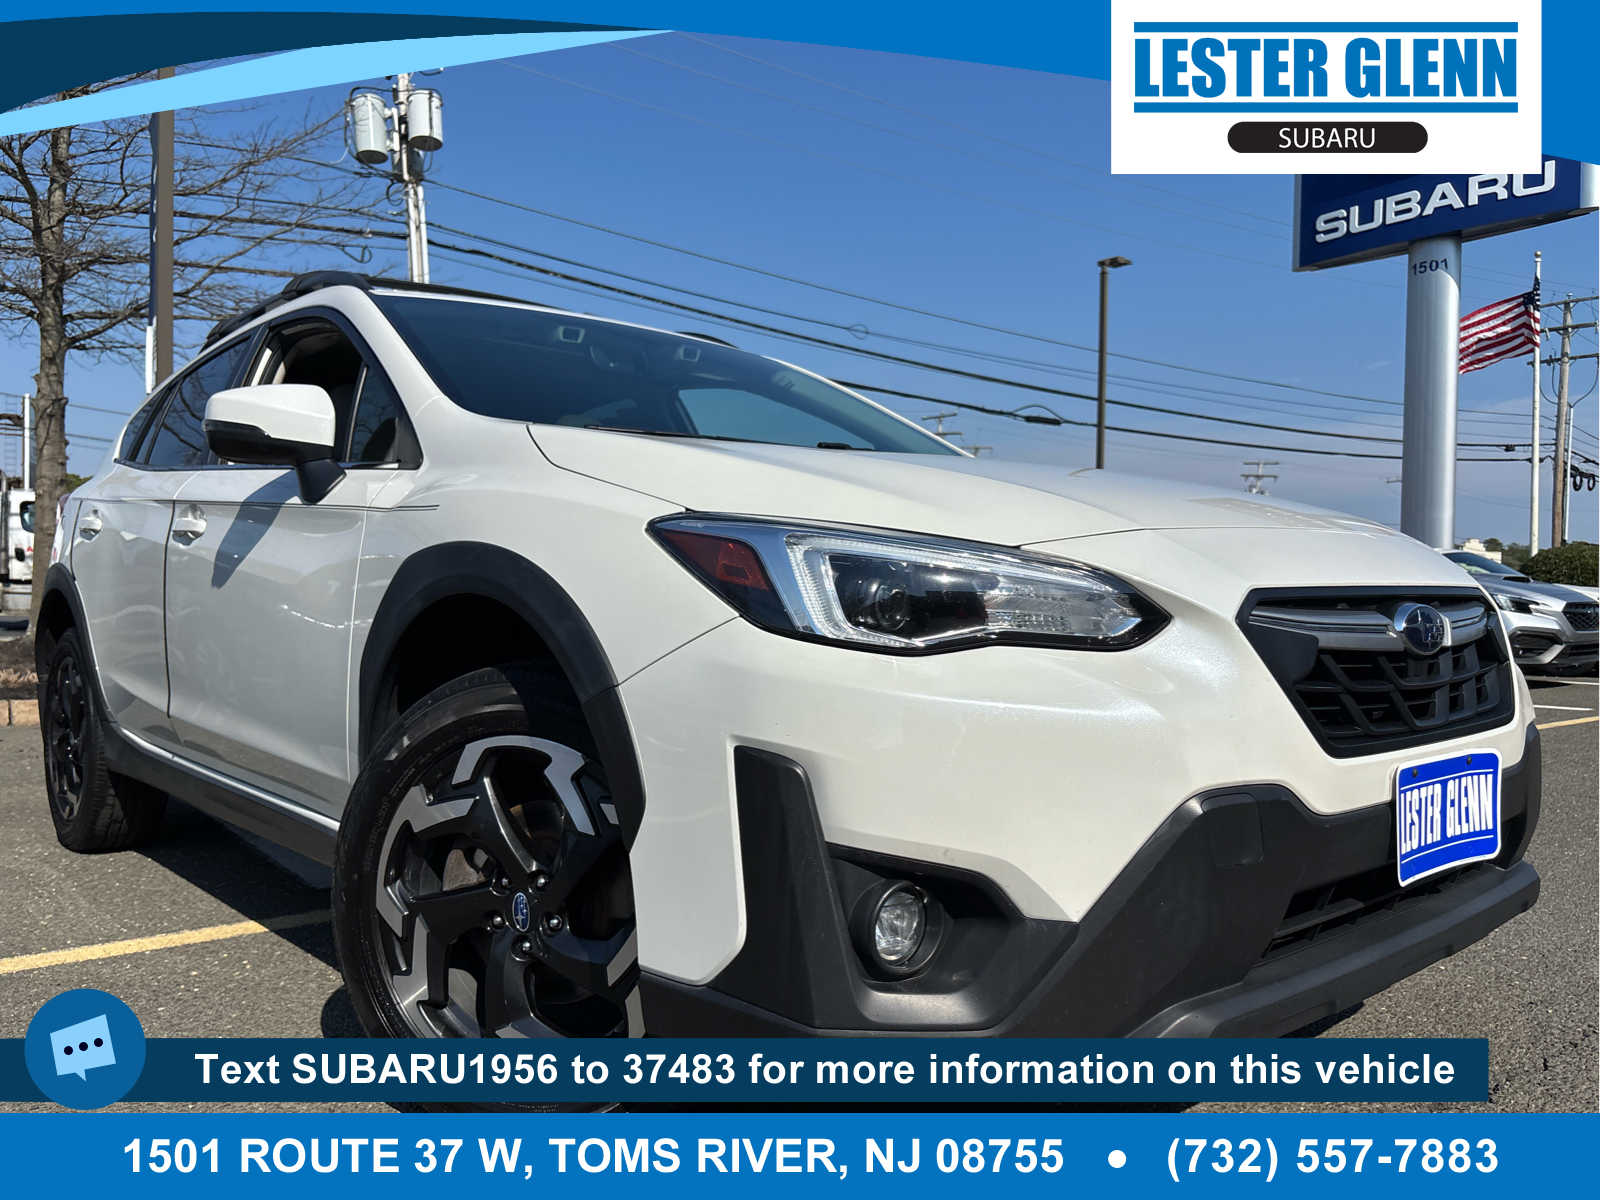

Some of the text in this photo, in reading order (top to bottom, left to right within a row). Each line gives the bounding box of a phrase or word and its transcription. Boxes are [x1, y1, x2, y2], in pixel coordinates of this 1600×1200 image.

[1315, 160, 1556, 243] SUBARU
[1412, 258, 1449, 275] 1501
[1400, 773, 1493, 855] LESTER GLENN
